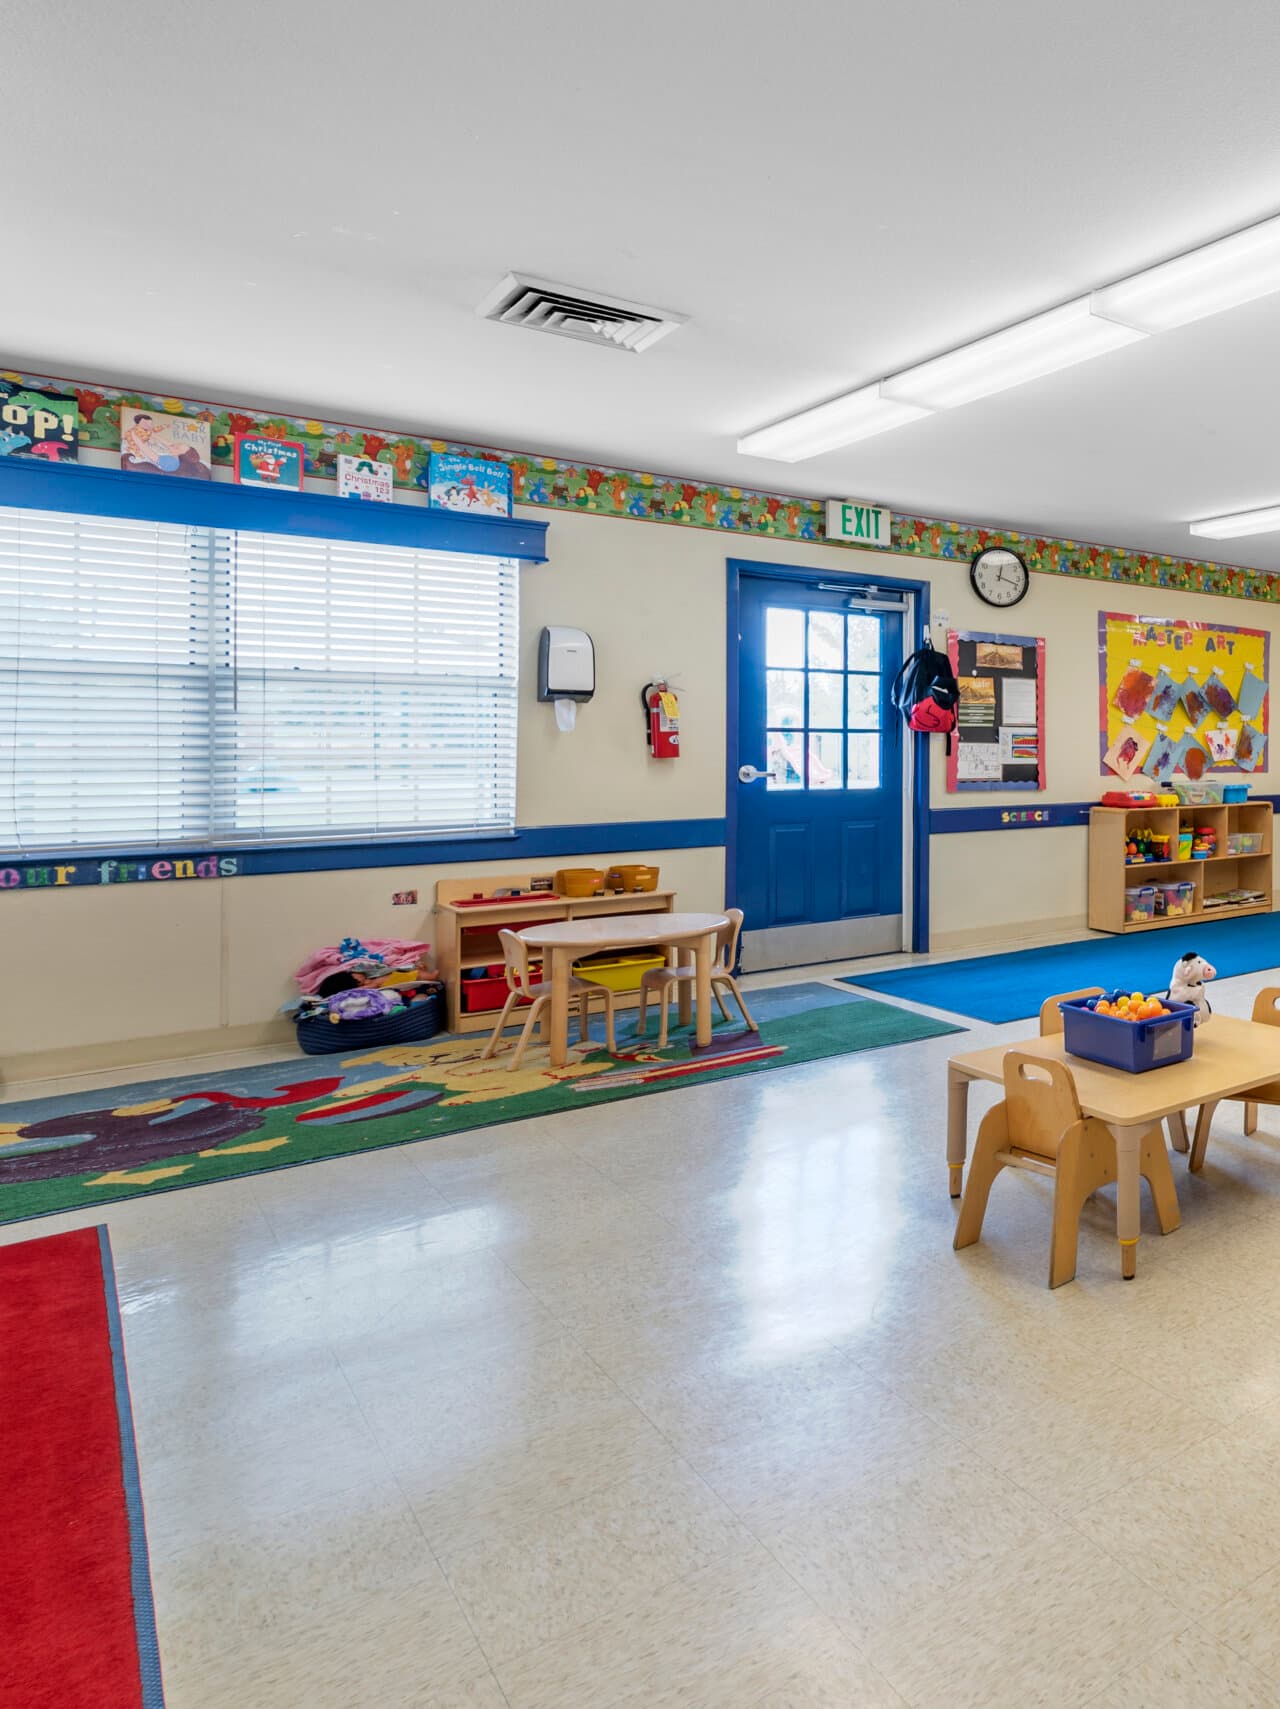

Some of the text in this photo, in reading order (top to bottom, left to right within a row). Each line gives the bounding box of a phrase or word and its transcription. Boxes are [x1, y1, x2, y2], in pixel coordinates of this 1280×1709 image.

[244, 442, 298, 458] Christmas
[468, 463, 485, 473] Bell
[344, 472, 390, 488] Christmas
[841, 504, 882, 540] EXIT
[1133, 626, 1235, 655] MASTER ART
[1001, 810, 1049, 823] SCIENCE
[0, 856, 238, 888] our friends
